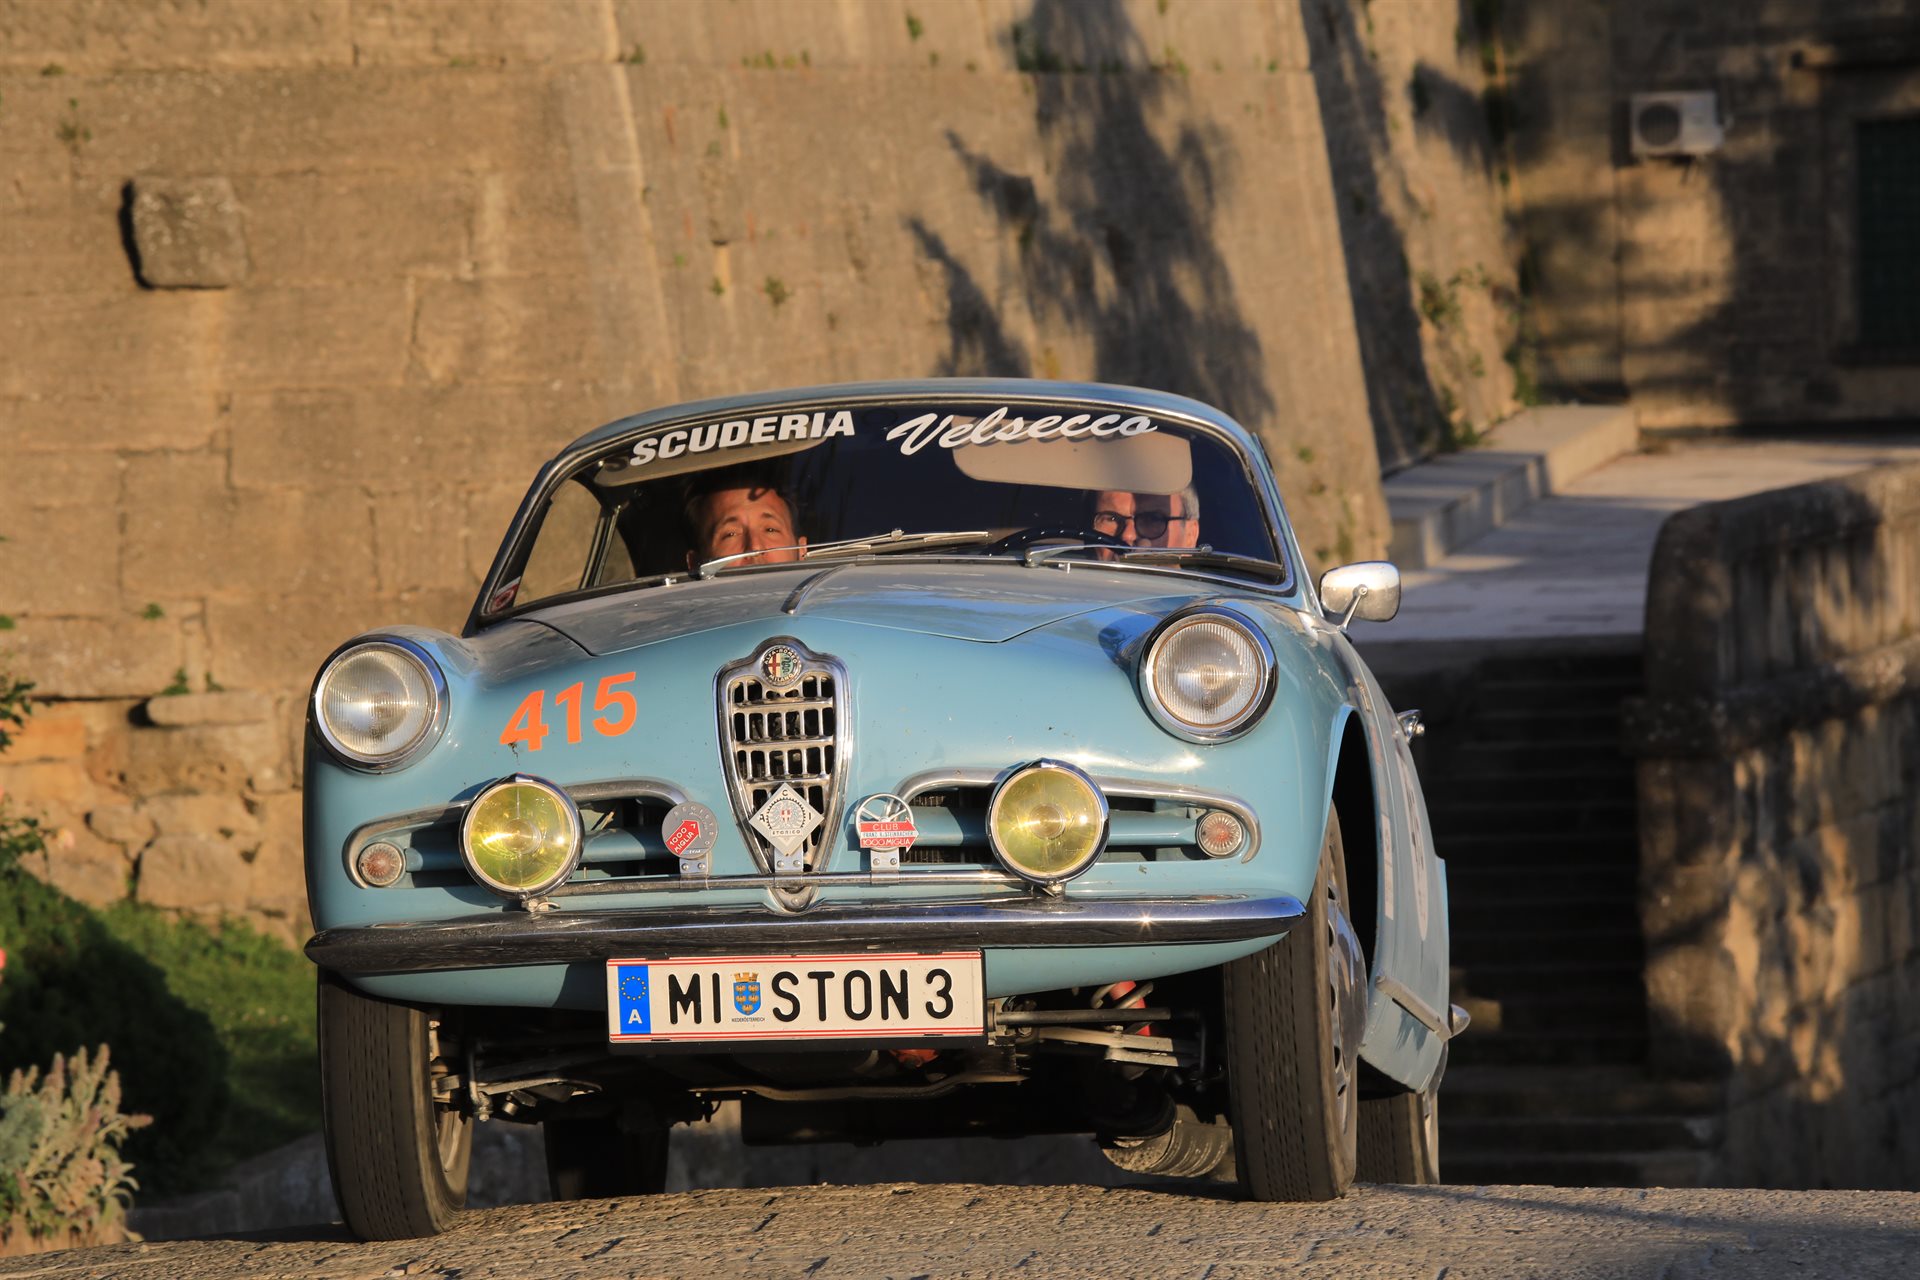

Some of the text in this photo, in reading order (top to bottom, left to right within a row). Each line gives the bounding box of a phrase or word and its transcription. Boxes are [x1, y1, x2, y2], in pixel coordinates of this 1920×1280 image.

[630, 407, 1158, 466] SCUDERIA Velsecco
[499, 671, 637, 752] 415
[669, 827, 687, 846] 1000
[872, 823, 899, 831] CLUB
[674, 831, 695, 853] MIGLIA
[668, 972, 722, 1024] MI
[628, 1009, 642, 1024] A
